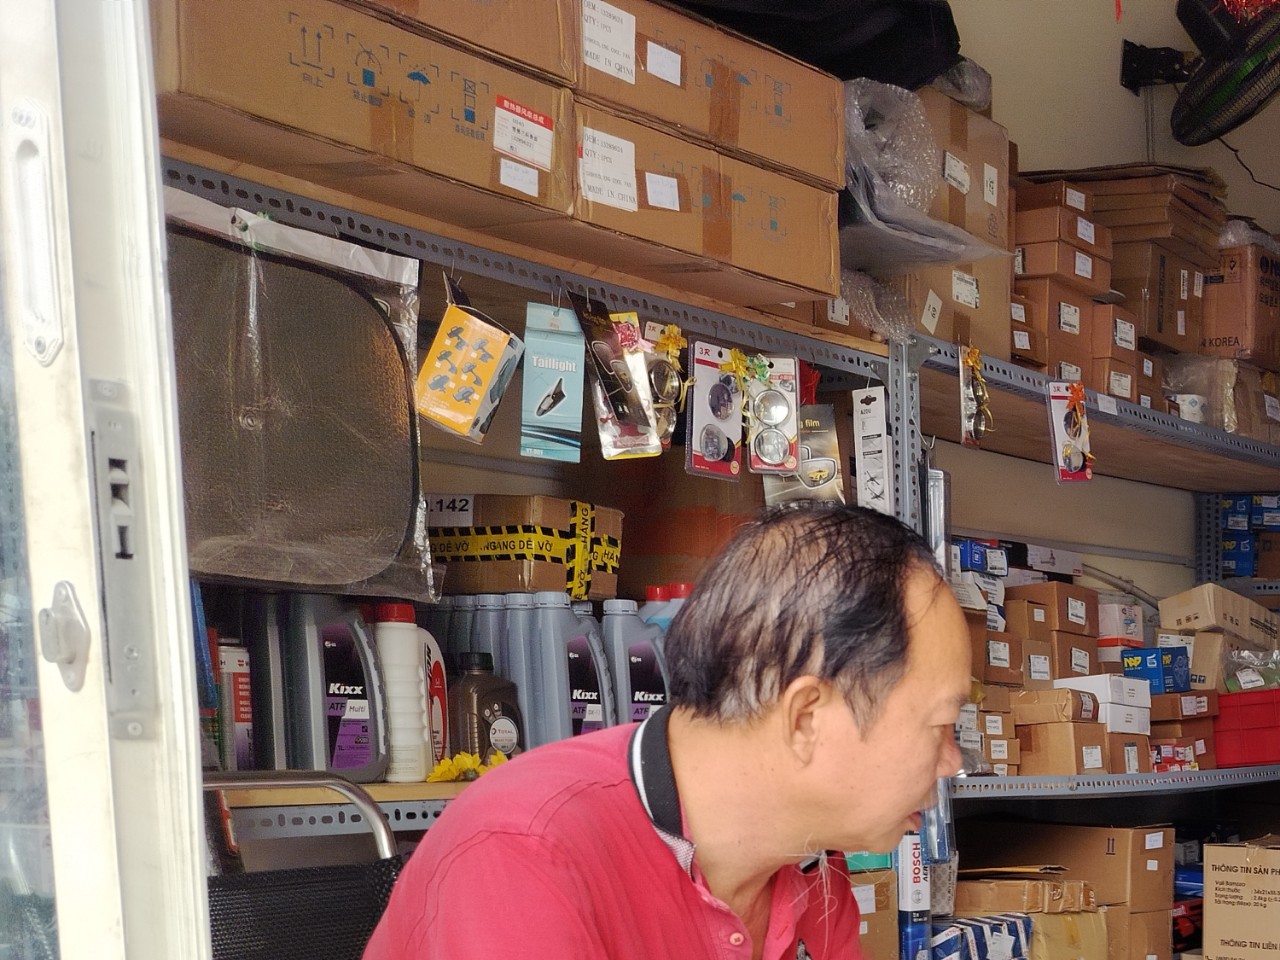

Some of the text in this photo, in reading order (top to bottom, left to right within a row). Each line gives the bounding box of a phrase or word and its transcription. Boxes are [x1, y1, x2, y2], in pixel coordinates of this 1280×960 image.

[1208, 336, 1240, 348] KOREA
[532, 355, 577, 373] Taillight
[329, 683, 363, 695] Kixx
[572, 689, 598, 700] Kixx
[634, 691, 664, 701] Kixx
[329, 702, 345, 711] ATF
[913, 842, 921, 884] BOSCH
[1212, 863, 1239, 873] THÔNG
[1240, 866, 1252, 874] TIN
[1253, 865, 1269, 875] SẢN
[1220, 939, 1247, 948] THÔNG
[1249, 941, 1260, 949] TIN
